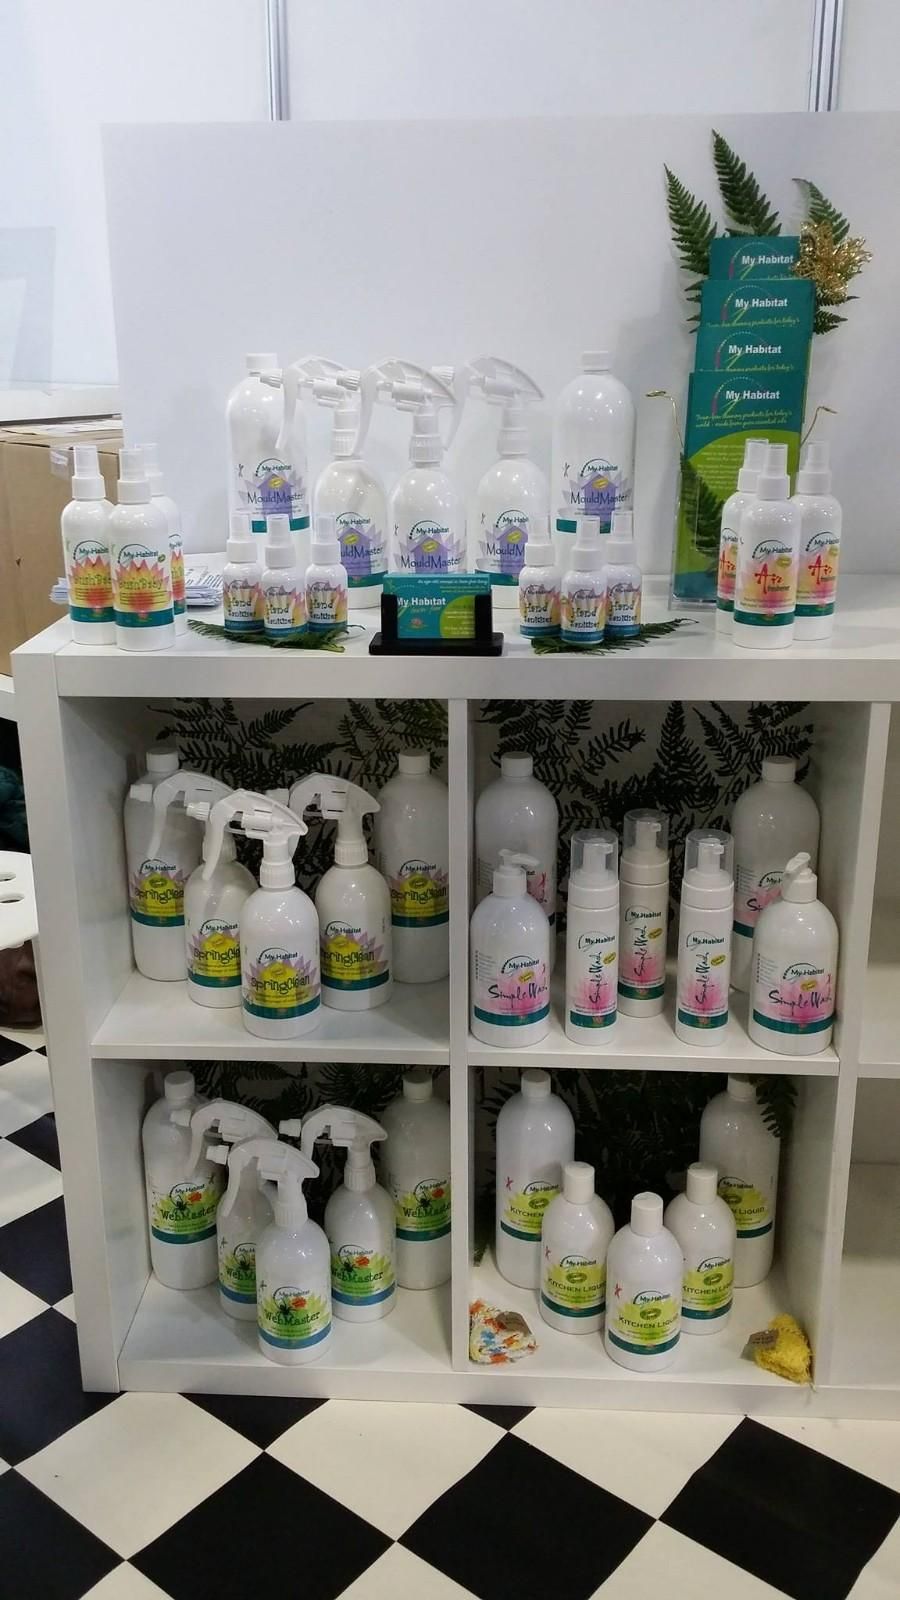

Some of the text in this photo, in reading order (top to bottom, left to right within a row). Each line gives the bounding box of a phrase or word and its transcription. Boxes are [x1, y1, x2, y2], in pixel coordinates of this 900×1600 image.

[741, 255, 794, 266] My Habitat
[735, 298, 788, 309] My Habitat
[728, 344, 782, 355] My Habitat
[725, 390, 780, 401] My Habitat
[247, 491, 304, 504] MouldMaster
[570, 491, 628, 505] MouldMaster
[350, 517, 371, 525] Habitat
[123, 550, 159, 559] My Habitat
[340, 545, 384, 559] uldMaster
[486, 543, 526, 556] MouldM
[759, 546, 793, 555] My Habitat
[400, 555, 461, 569] MouldMaster
[397, 597, 447, 607] My Habitat
[134, 887, 184, 904] SpringClea
[640, 911, 661, 919] Habitat
[216, 923, 238, 931] Habitat
[595, 935, 615, 944] Habitat
[702, 937, 724, 945] Habitat
[193, 945, 240, 965] SpringCle
[322, 949, 375, 967] pringClean
[520, 960, 539, 968] Habitat
[790, 967, 825, 977] My Habitat
[250, 975, 310, 995] SpringClean
[548, 1278, 581, 1293] KITCHEN
[264, 1308, 321, 1326] WebMaster
[618, 1316, 656, 1329] KITCHEN
